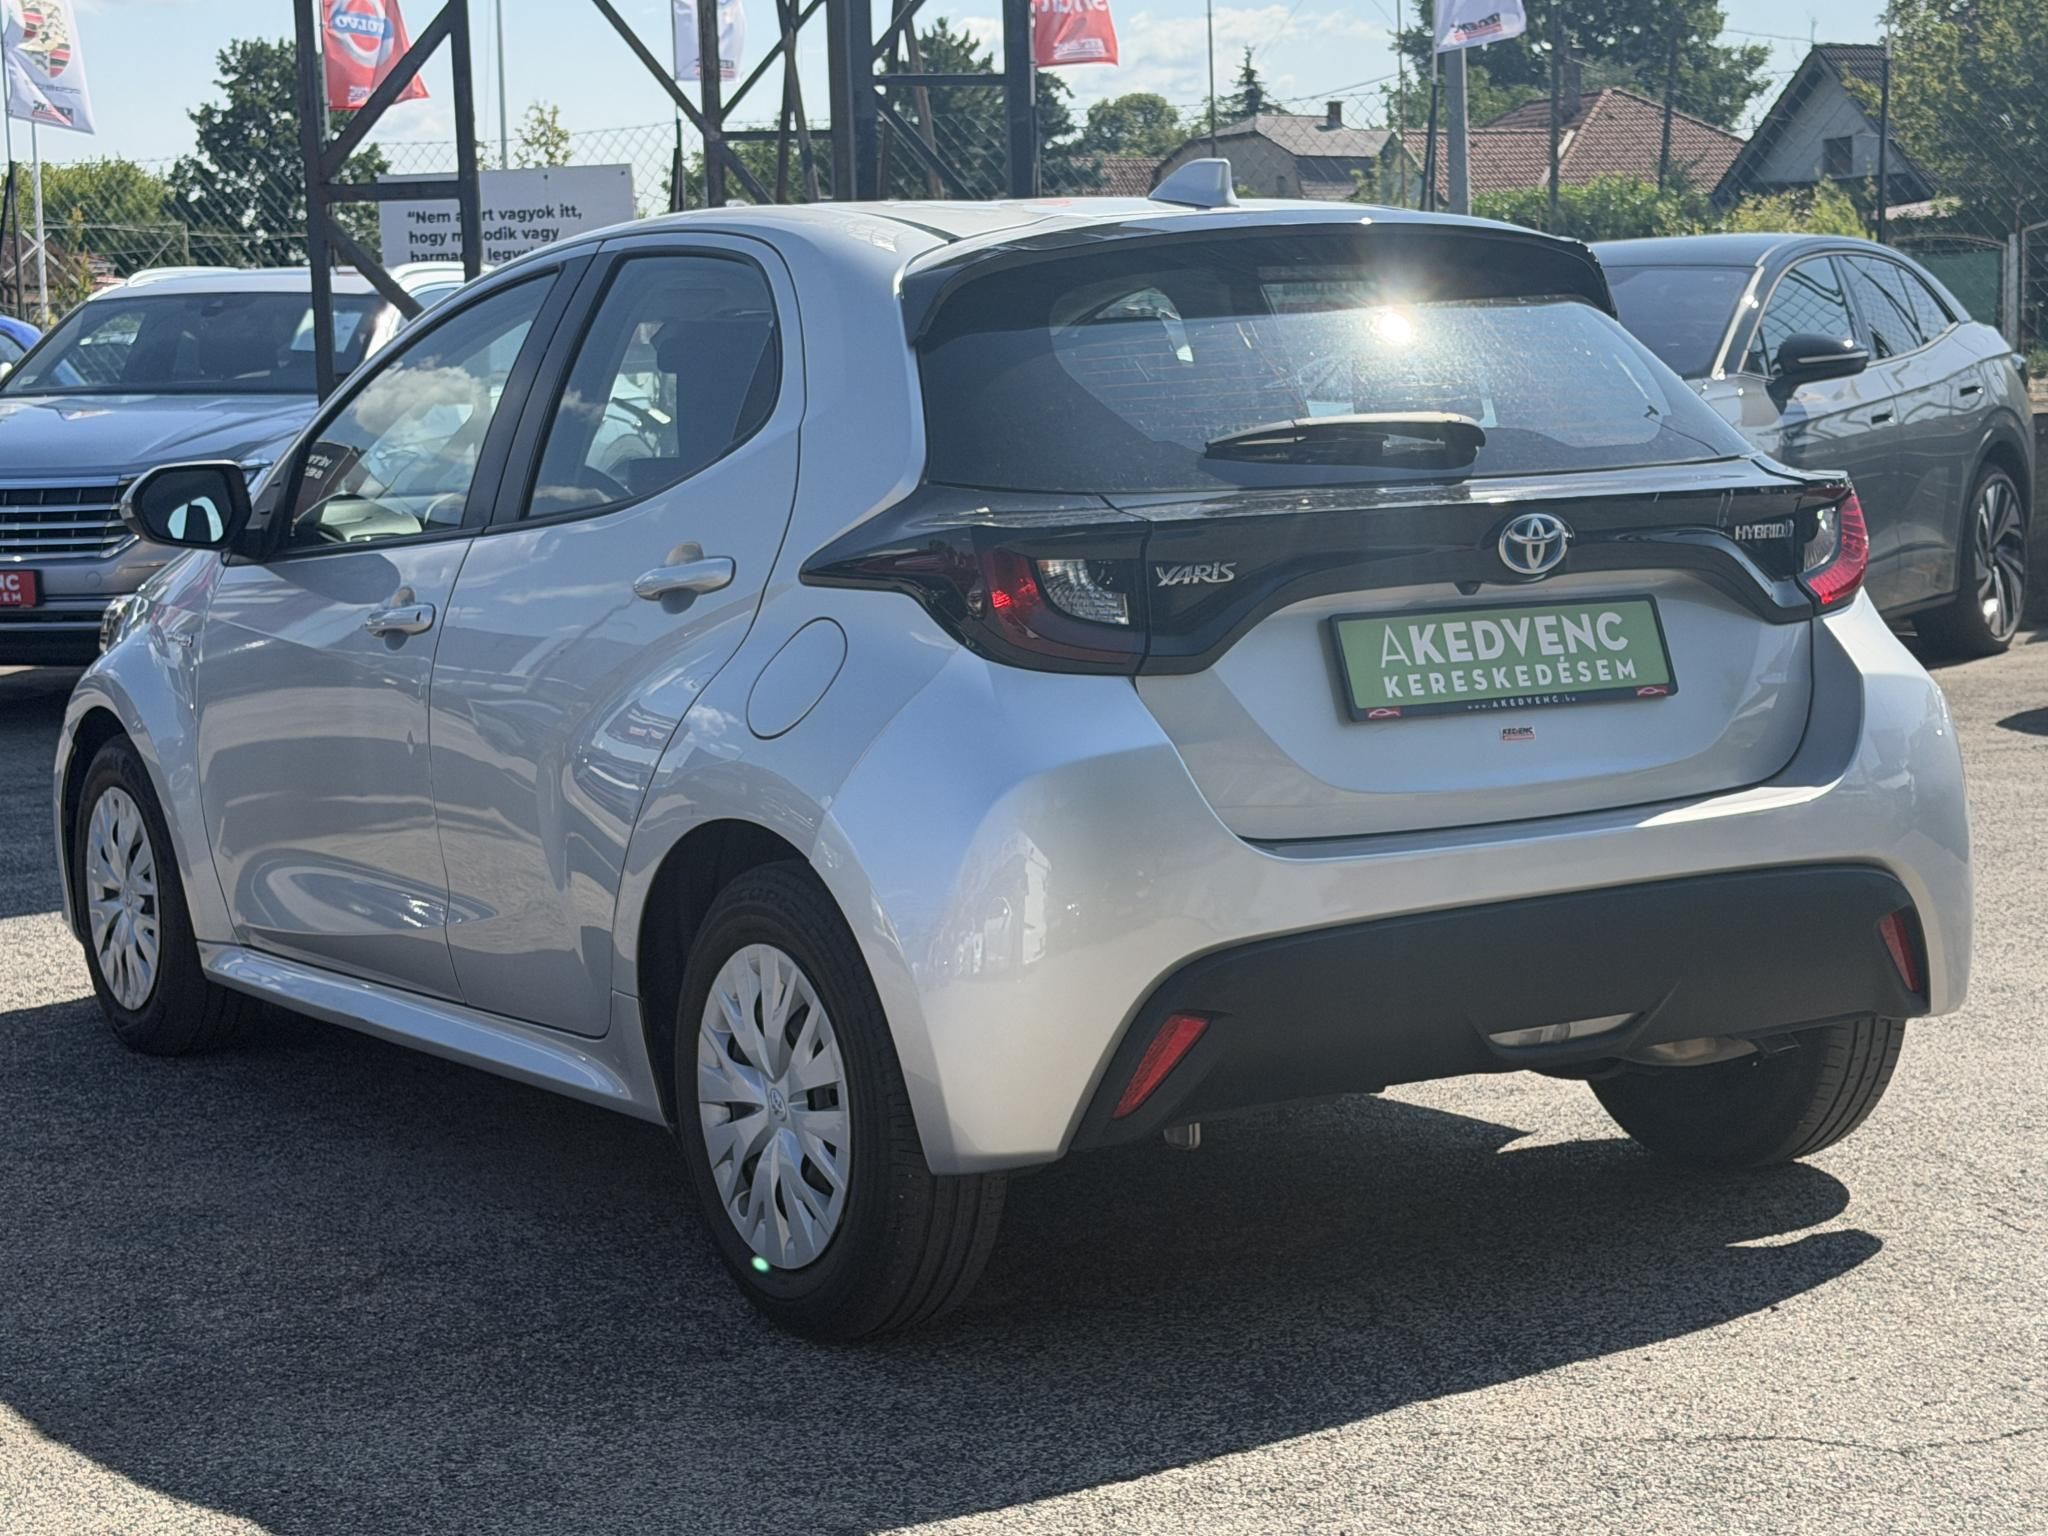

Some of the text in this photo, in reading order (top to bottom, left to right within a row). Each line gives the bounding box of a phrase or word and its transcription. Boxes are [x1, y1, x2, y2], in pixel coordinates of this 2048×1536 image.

[456, 208, 494, 222] art
[500, 205, 555, 223] vagyok
[560, 203, 582, 219] itt,
[409, 227, 560, 247] hogy modik vagy
[1735, 522, 1786, 540] HYBRID
[1155, 562, 1237, 587] YARIS
[1381, 611, 1629, 669] AKEDVENC
[1384, 656, 1637, 698] KERESKEDÉSEM
